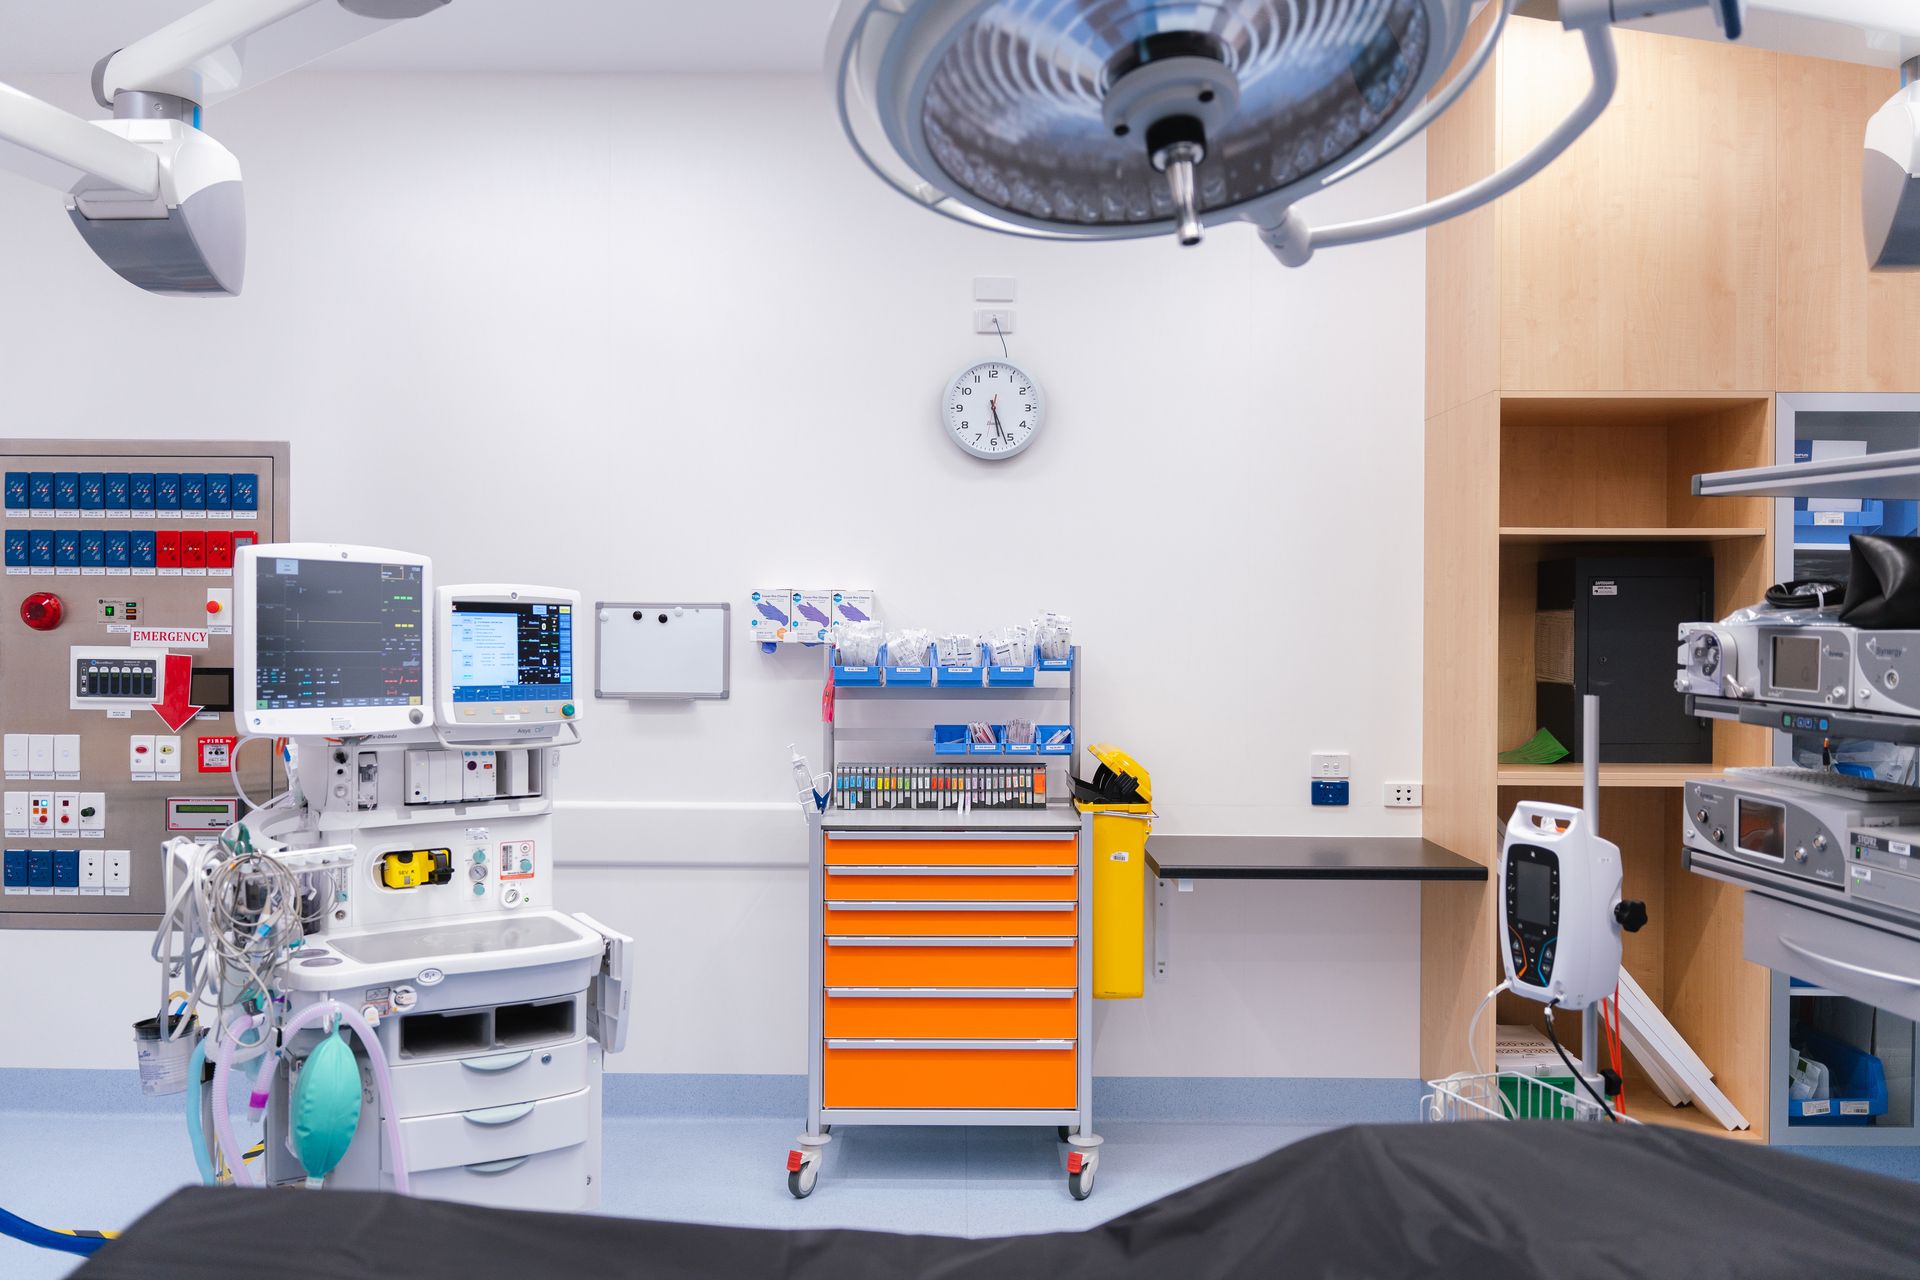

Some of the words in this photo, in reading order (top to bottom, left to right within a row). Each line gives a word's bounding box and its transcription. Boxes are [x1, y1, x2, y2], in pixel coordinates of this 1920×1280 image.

[988, 370, 998, 378] 12
[1025, 404, 1031, 412] 3
[975, 434, 982, 442] 7
[1007, 433, 1014, 441] 5
[133, 631, 207, 642] EMERGENCY
[1857, 835, 1877, 846] STORZ
